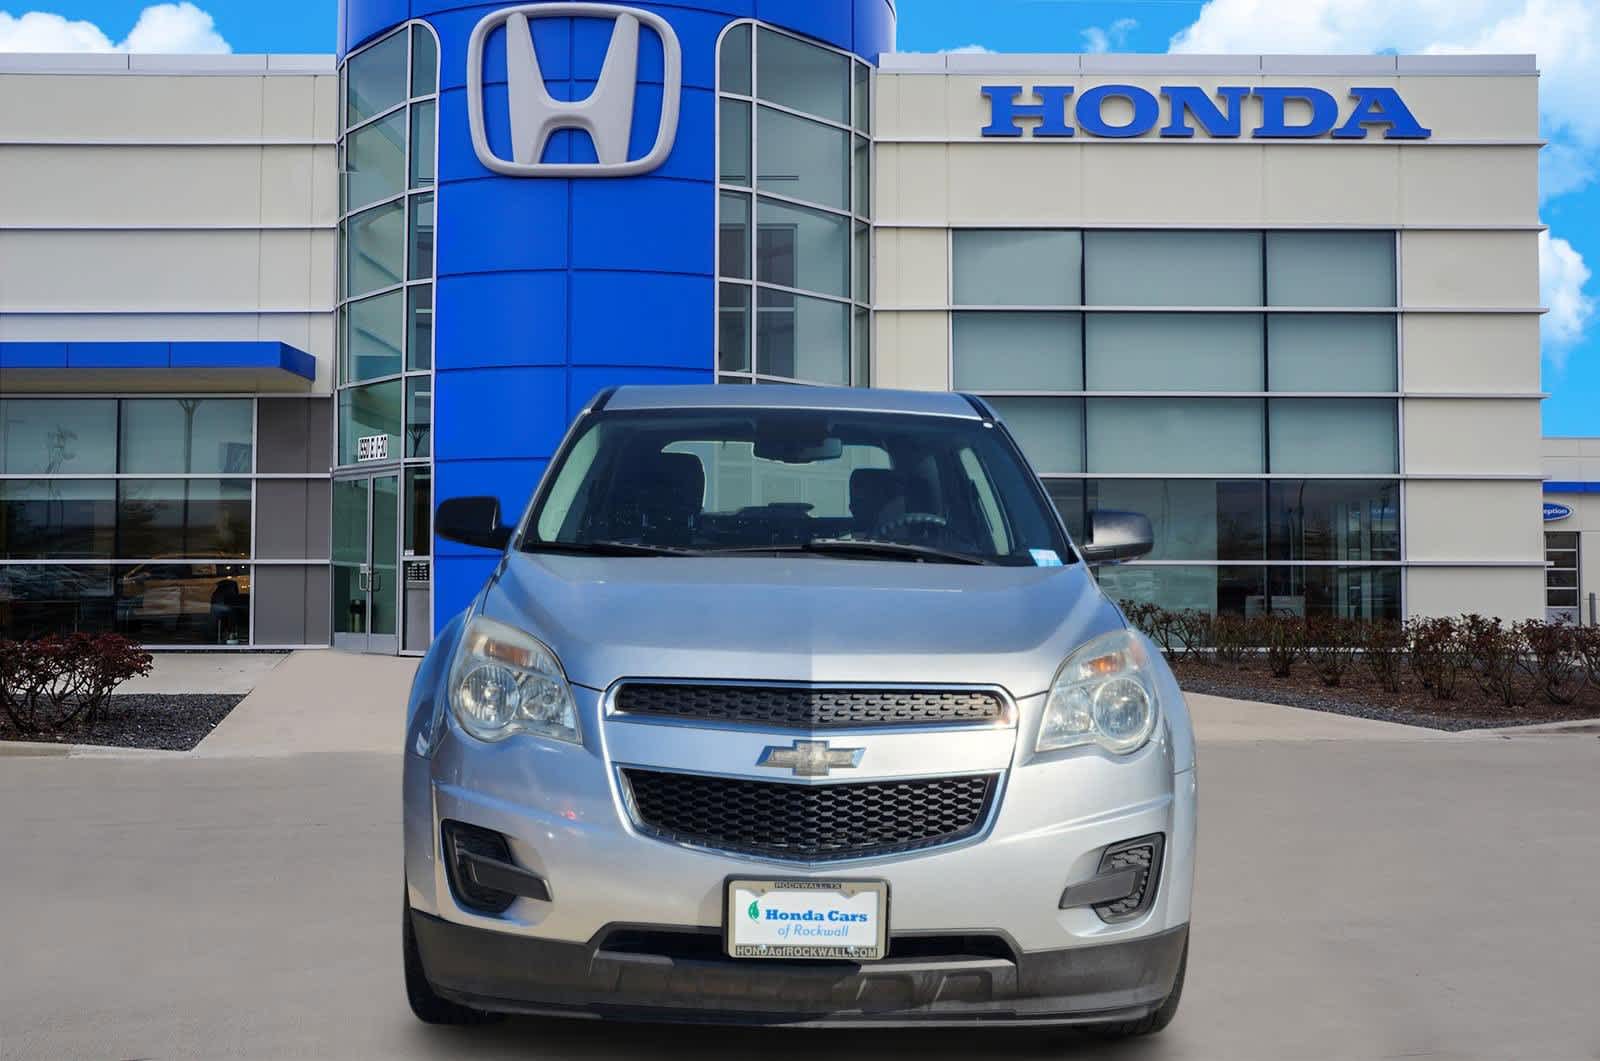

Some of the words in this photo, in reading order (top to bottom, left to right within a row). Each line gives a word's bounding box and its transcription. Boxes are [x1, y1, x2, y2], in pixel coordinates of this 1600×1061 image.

[981, 84, 1432, 139] HONDA
[765, 909, 824, 922] Honda
[827, 910, 868, 923] Cars
[777, 924, 791, 938] of
[794, 924, 849, 937] Rockwall
